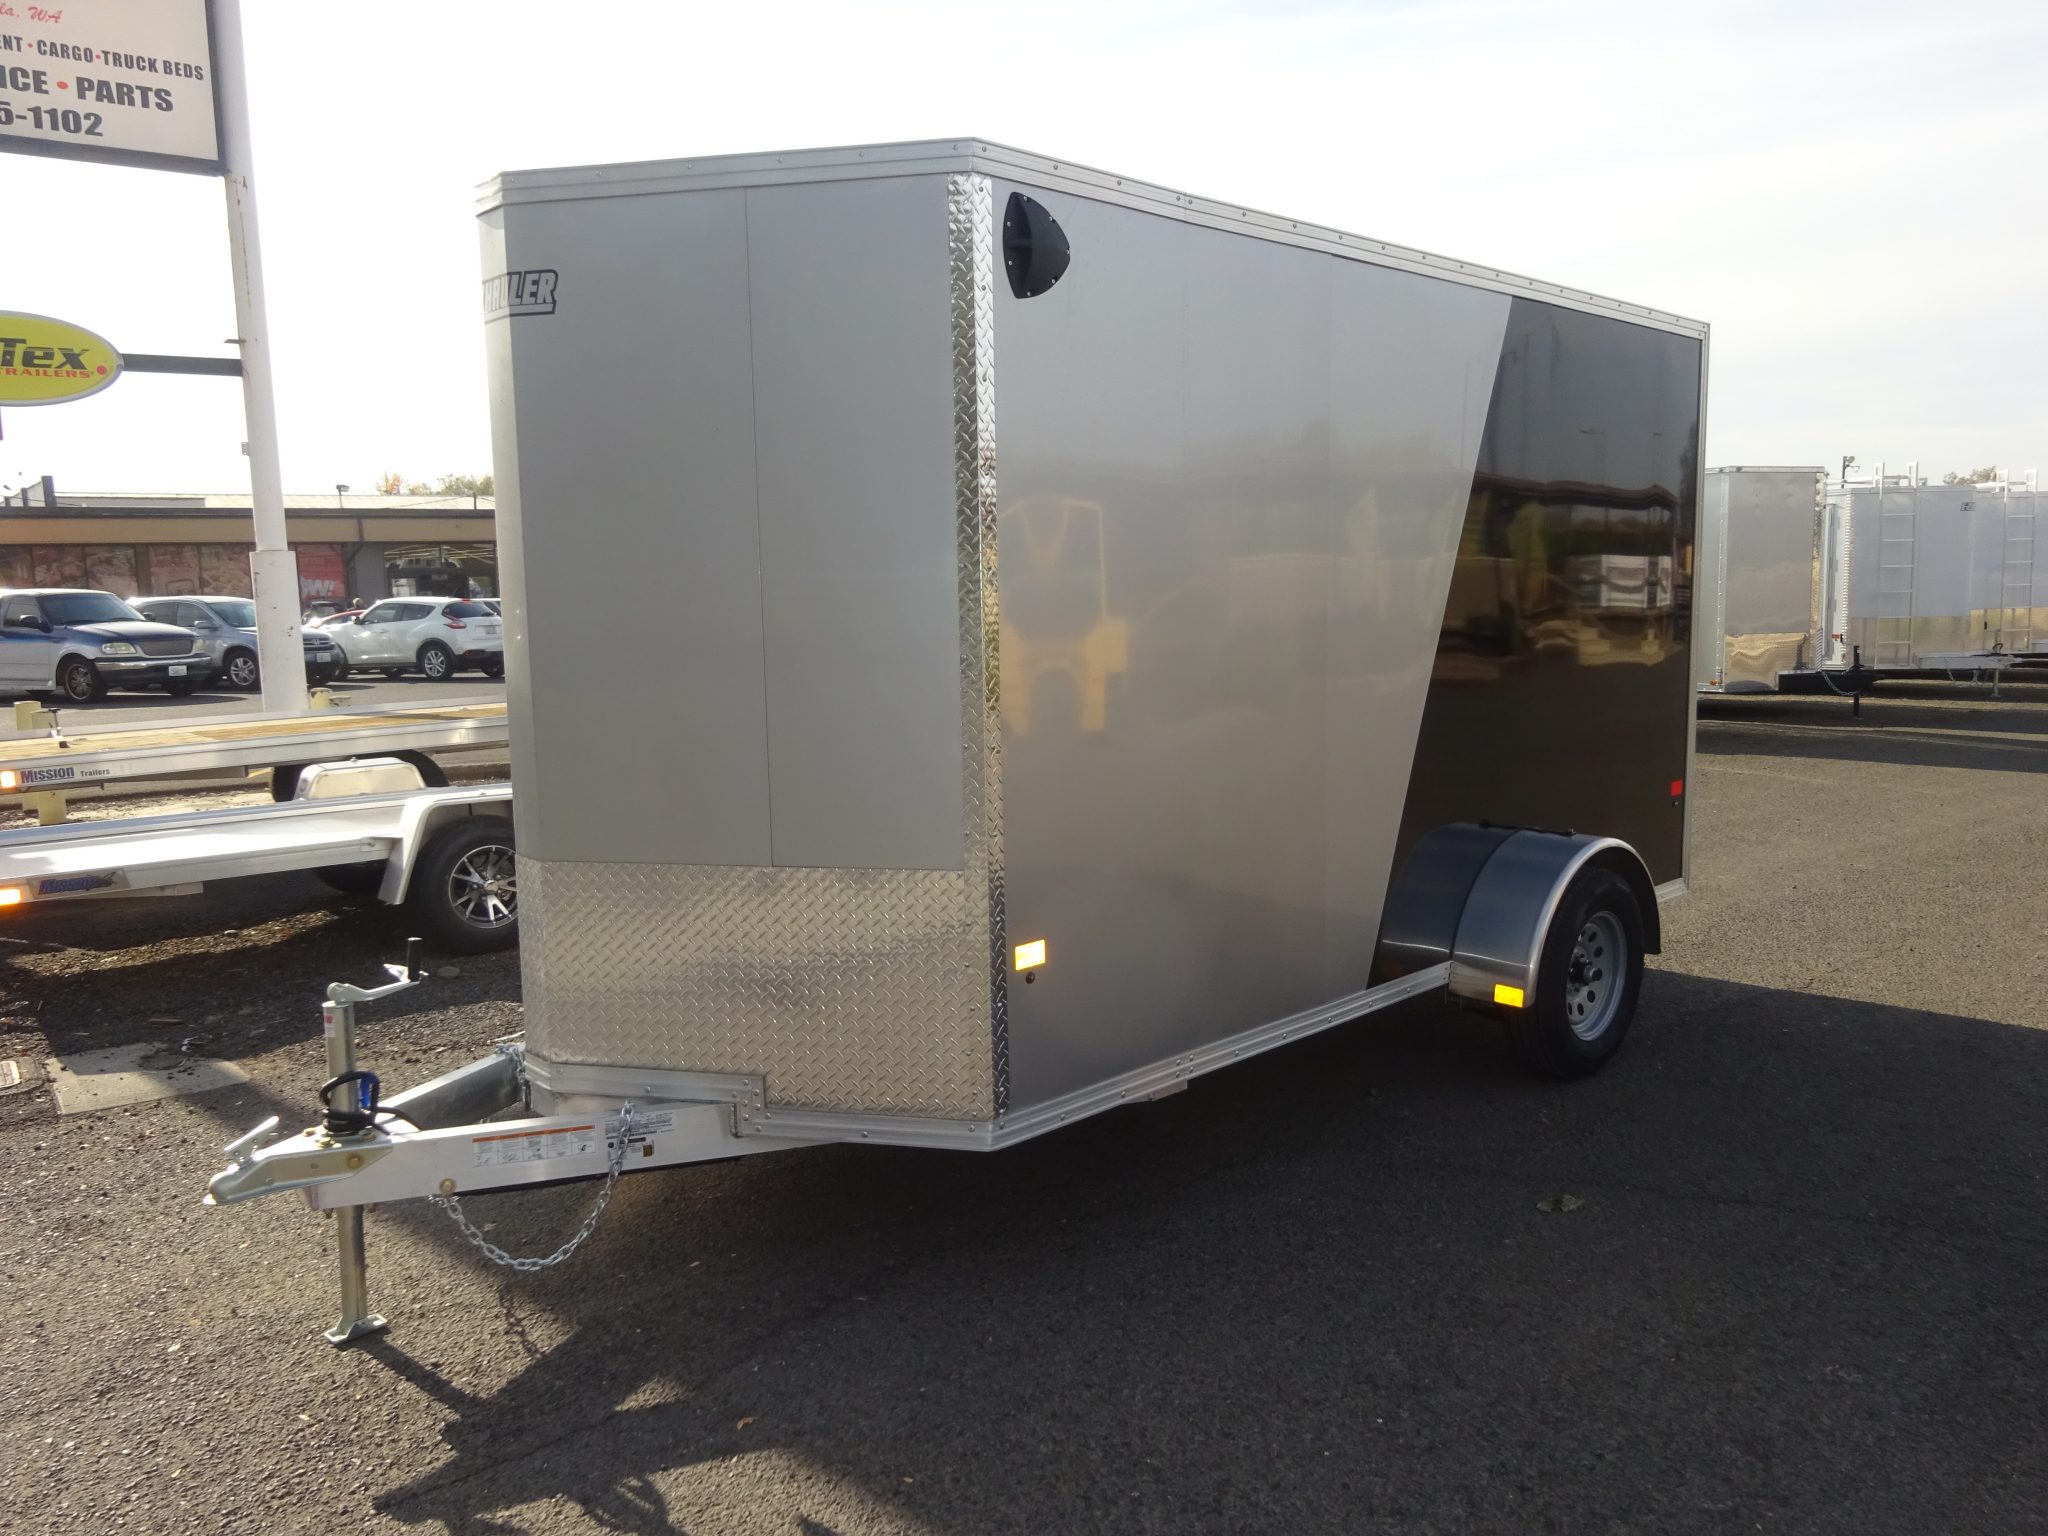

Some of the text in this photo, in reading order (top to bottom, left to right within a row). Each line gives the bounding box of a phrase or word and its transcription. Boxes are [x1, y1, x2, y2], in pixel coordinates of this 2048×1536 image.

[0, 34, 204, 81] NT CARGO TRUCK BEDS
[76, 76, 174, 112] PARTS
[0, 367, 91, 379] RAILERS
[80, 769, 110, 777] Trailers
